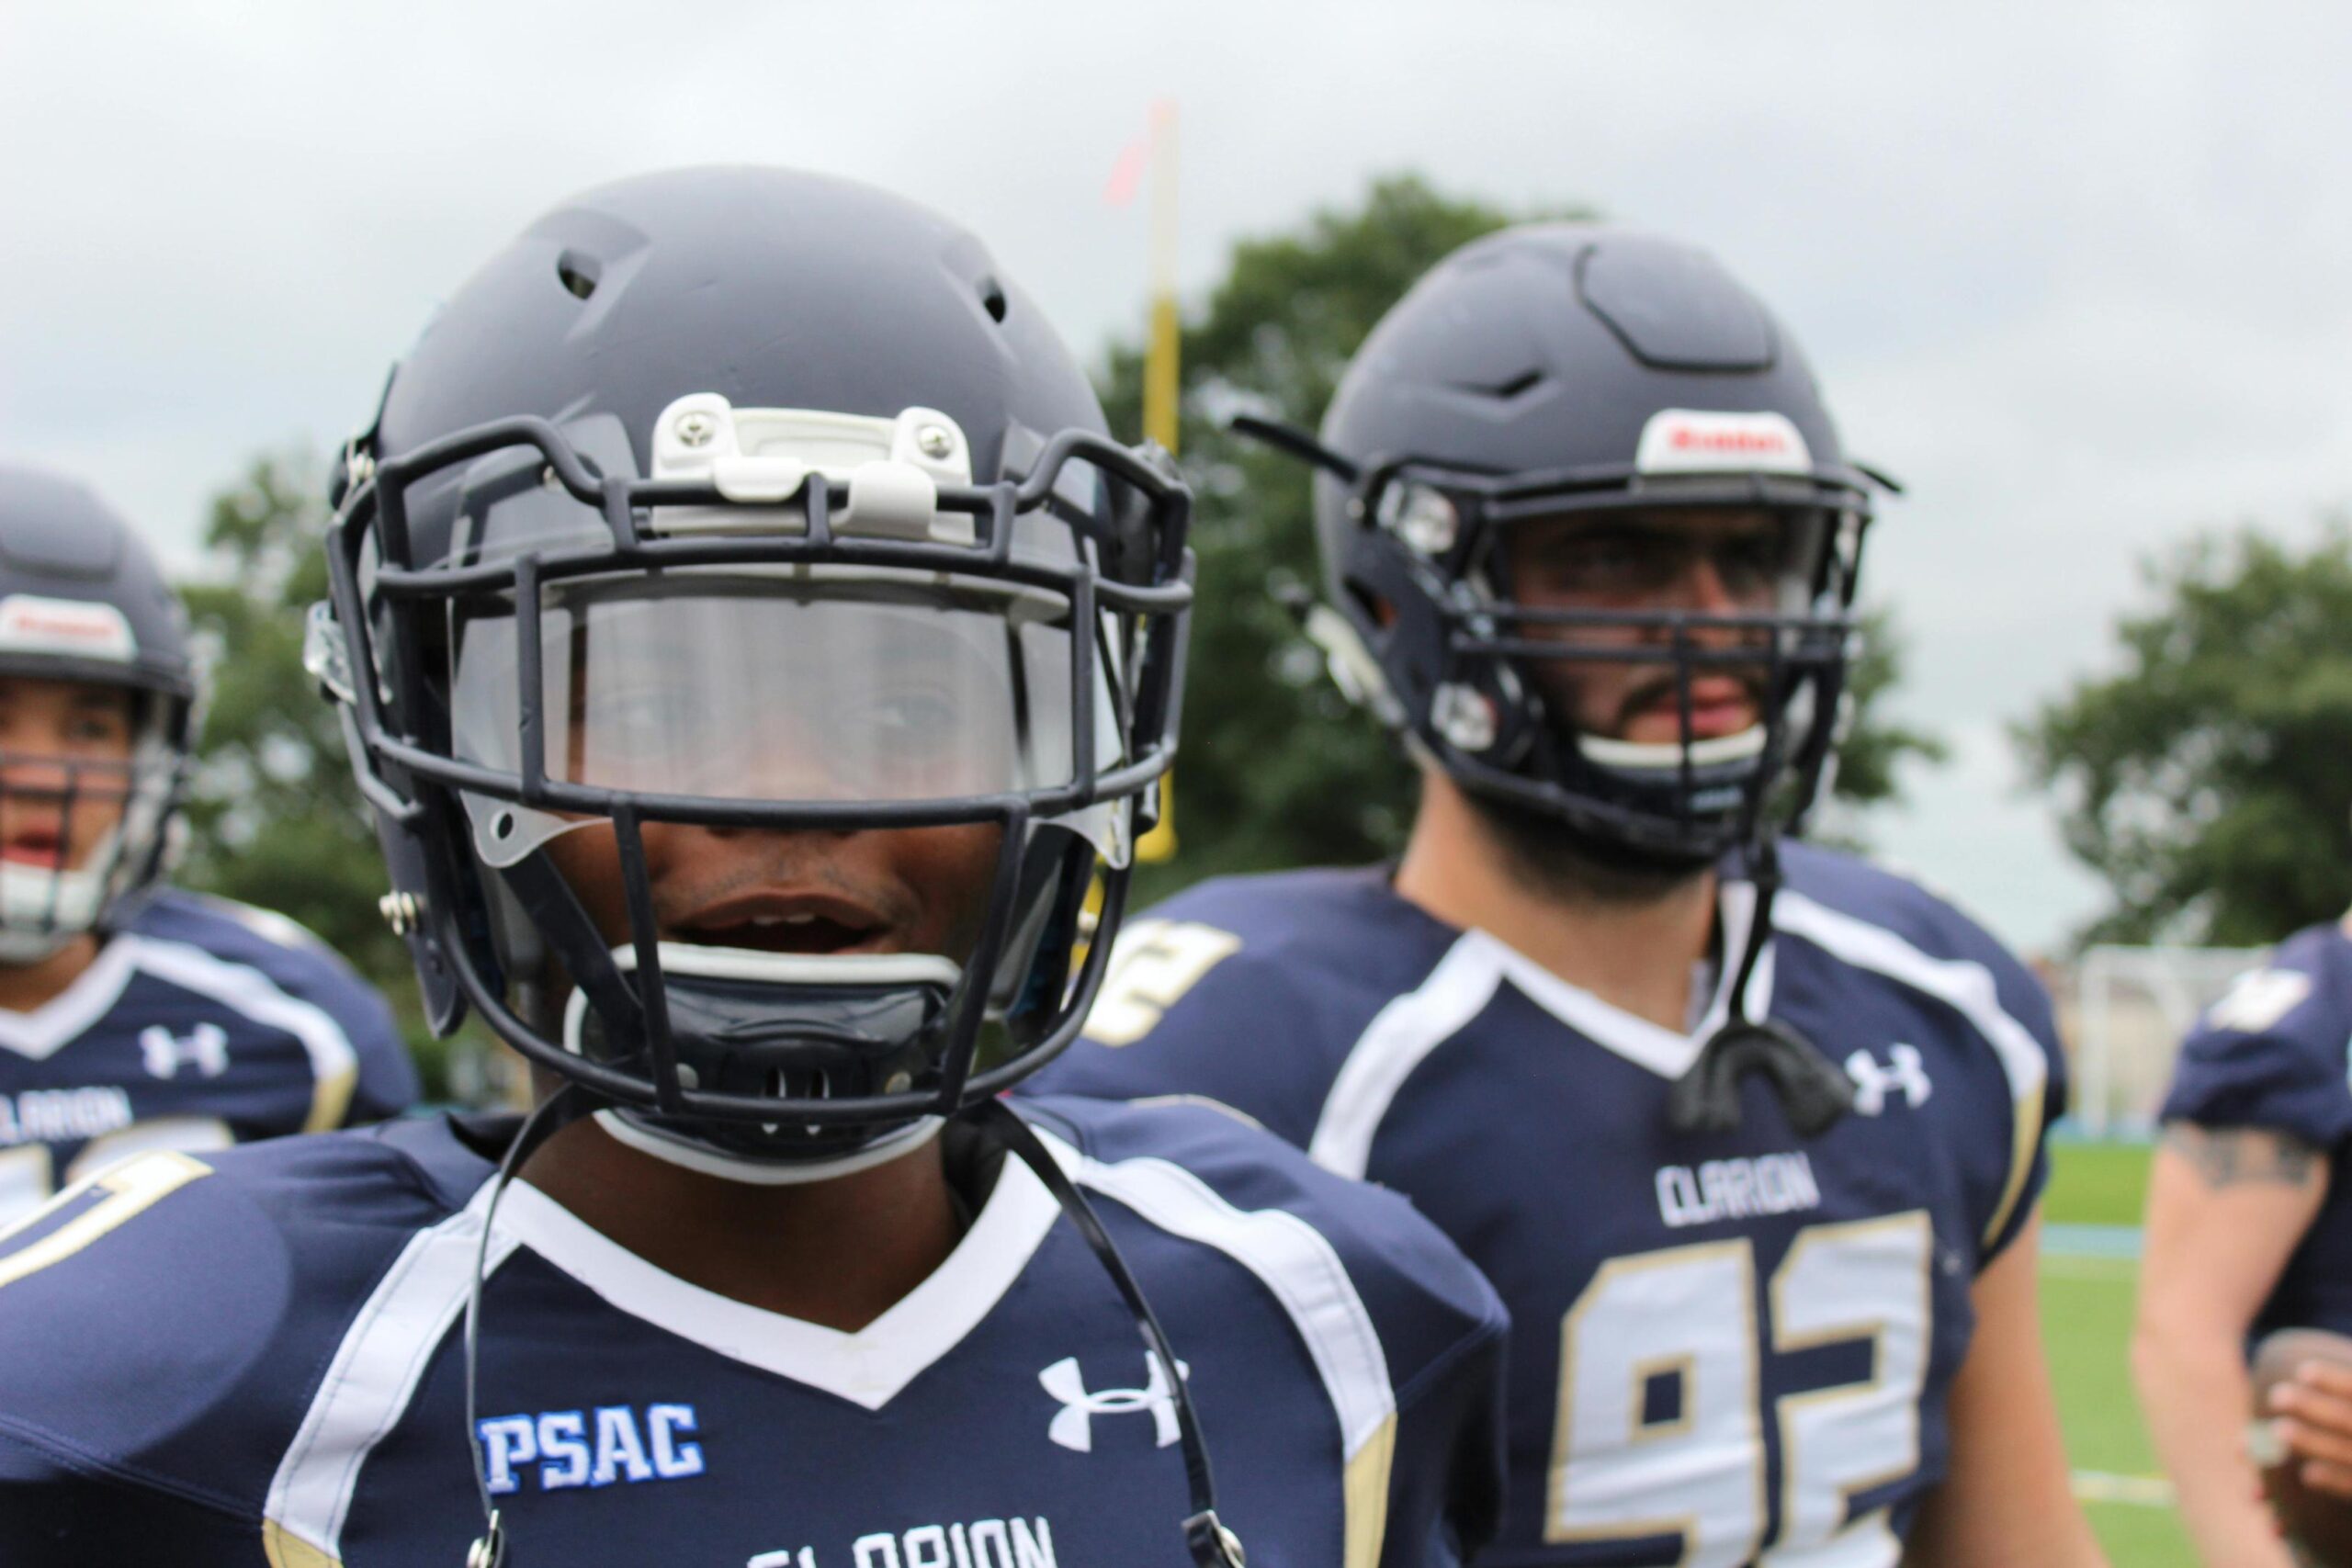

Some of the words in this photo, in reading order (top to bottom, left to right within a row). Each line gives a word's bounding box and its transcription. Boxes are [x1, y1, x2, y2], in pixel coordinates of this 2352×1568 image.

[1657, 1151, 1821, 1228] CLARION
[1543, 1207, 1935, 1568] 92
[475, 1402, 707, 1495] PSAC
